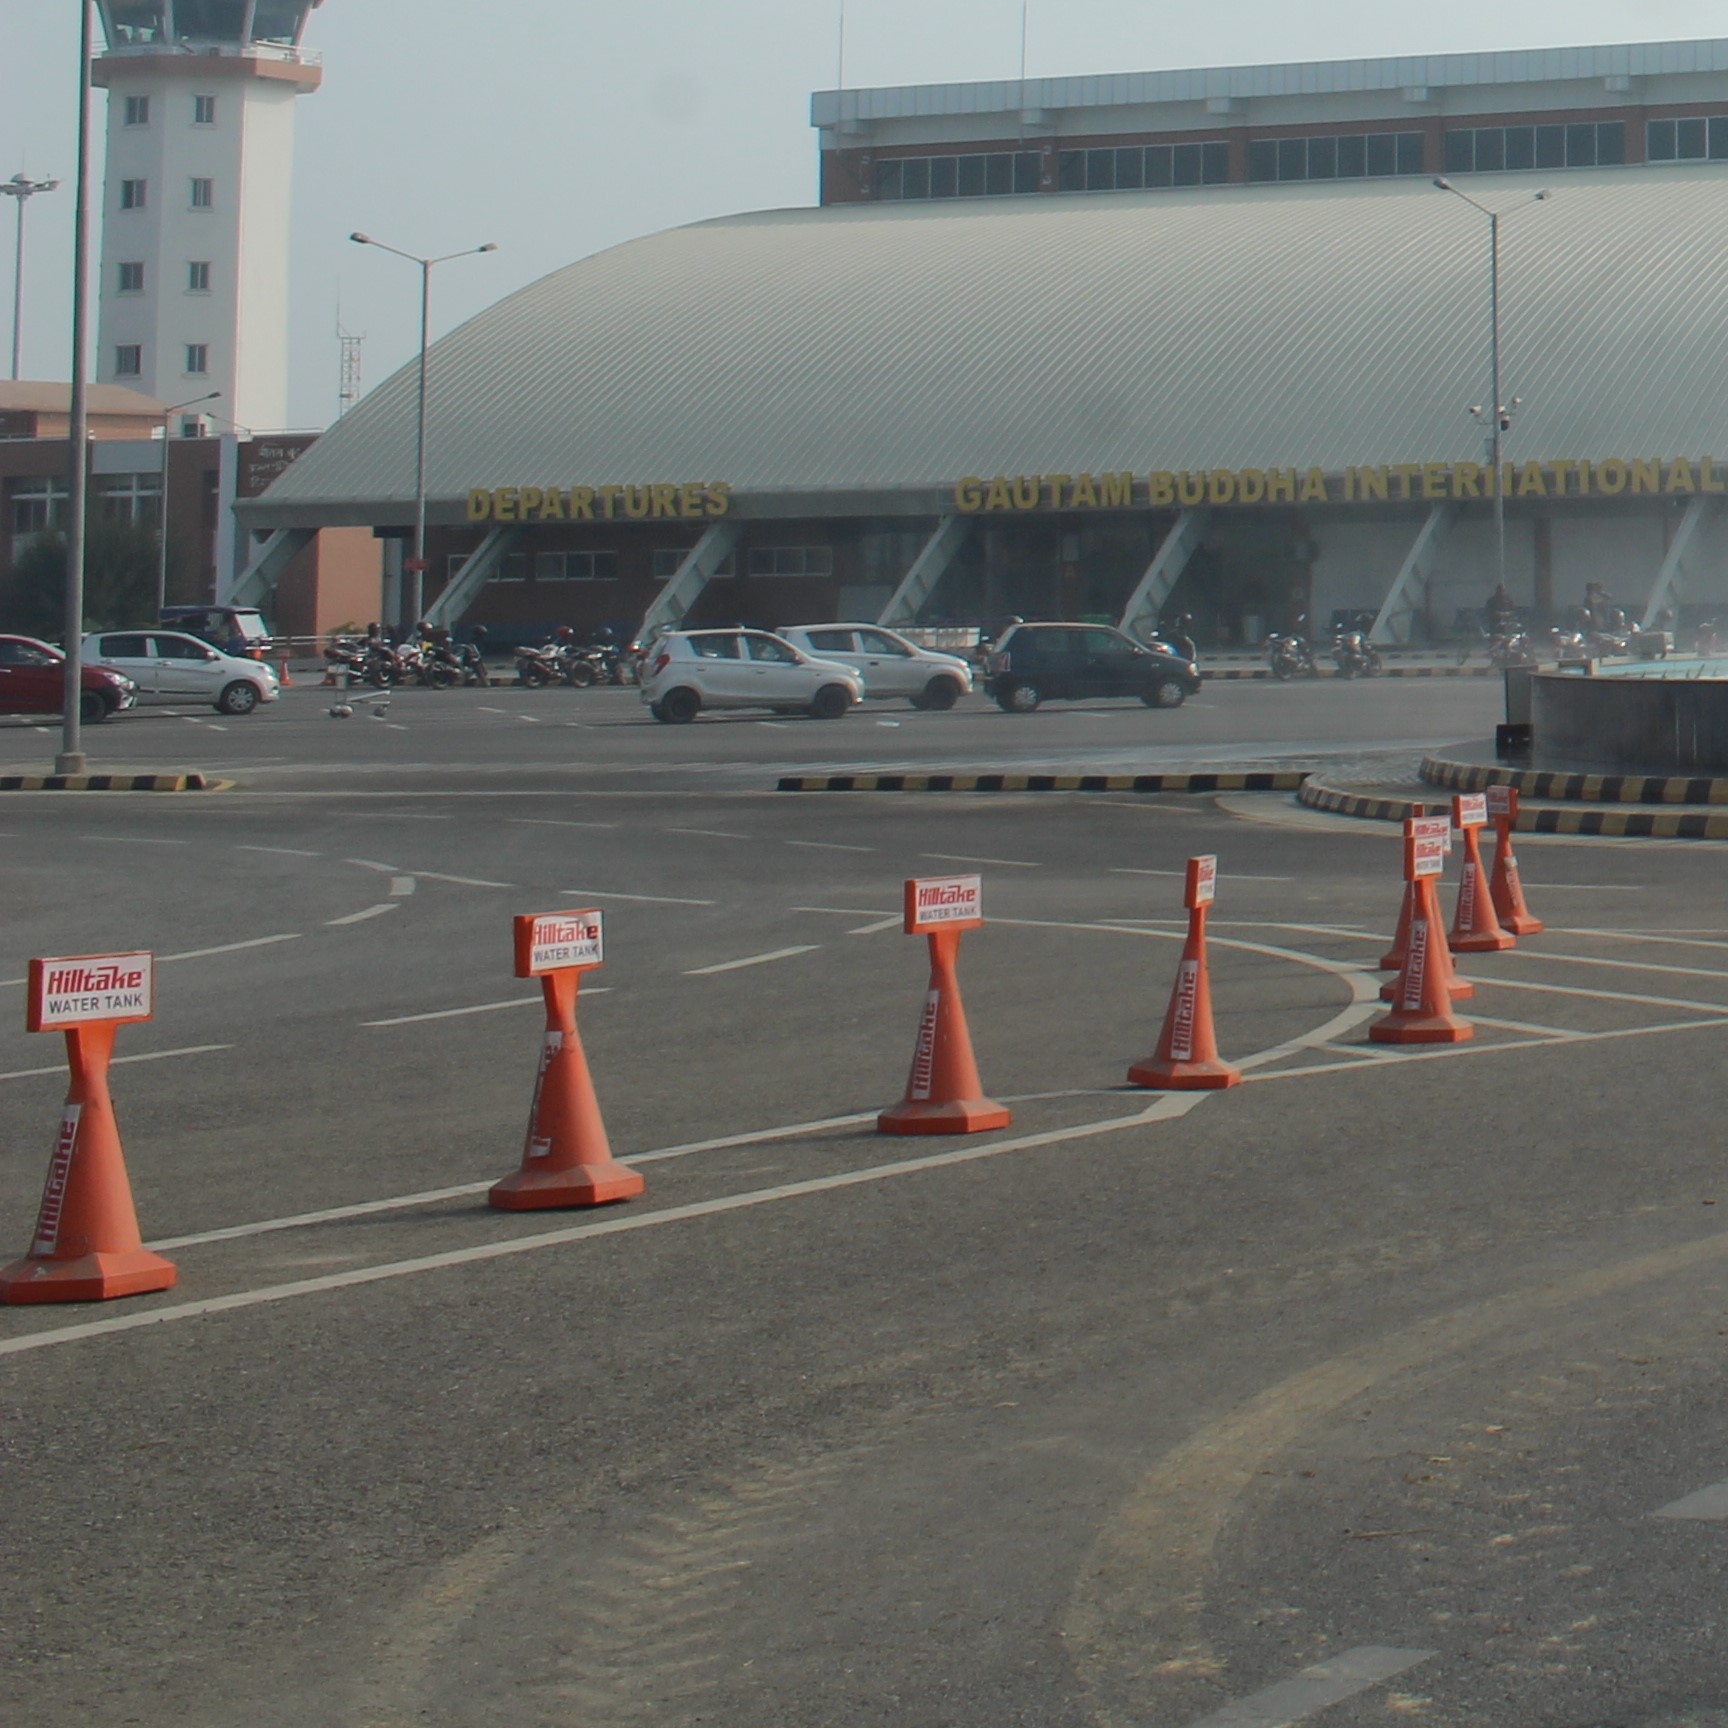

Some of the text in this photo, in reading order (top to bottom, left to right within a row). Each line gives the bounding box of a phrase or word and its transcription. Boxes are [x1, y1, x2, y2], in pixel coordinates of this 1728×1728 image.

[467, 481, 731, 521] DEPARTURES
[954, 471, 1132, 511] GAUTAM
[1149, 467, 1328, 505] BUDDHA
[1343, 456, 1725, 501] INTERNATIONAL
[919, 884, 977, 906] Hilltake
[920, 905, 977, 921] WATER TANK
[534, 943, 600, 962] WATER TANK
[1406, 928, 1426, 1003] Hilltake
[47, 965, 143, 994] Hilltake
[49, 993, 144, 1014] WATER TANK
[1173, 971, 1196, 1052] Hilltake
[913, 1002, 937, 1090] Hilltake
[37, 1121, 76, 1242] Hilltake
